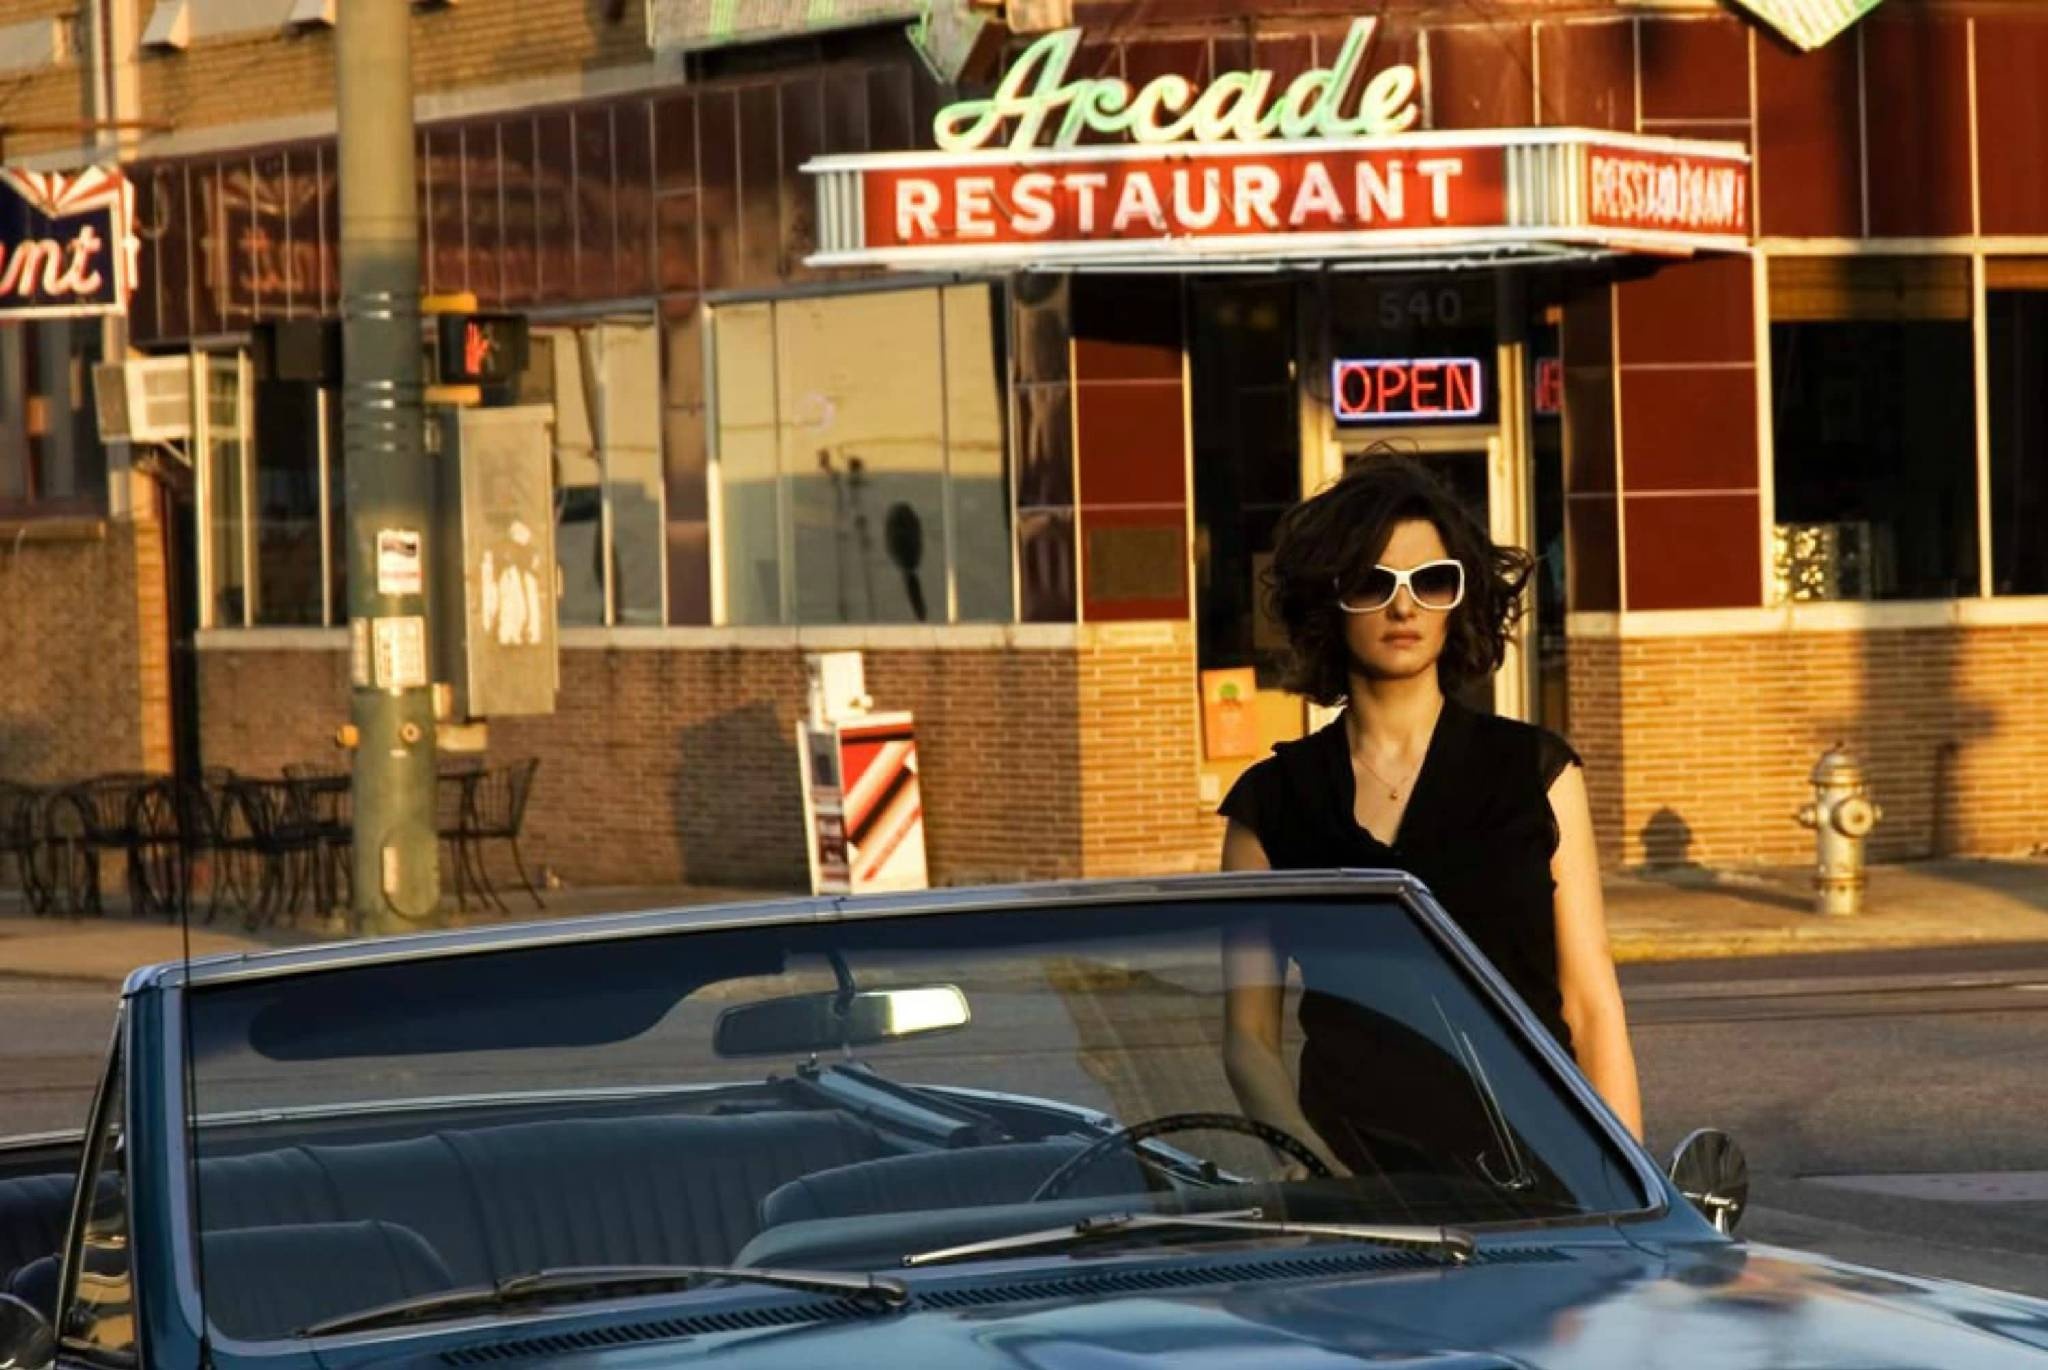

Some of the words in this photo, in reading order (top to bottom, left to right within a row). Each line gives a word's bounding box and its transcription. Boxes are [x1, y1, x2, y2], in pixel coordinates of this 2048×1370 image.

[934, 16, 1419, 151] Arcade
[895, 158, 1462, 238] RESTAURANT
[0, 224, 102, 297] nt
[1379, 289, 1461, 327] 540
[1340, 363, 1473, 413] OPEN
